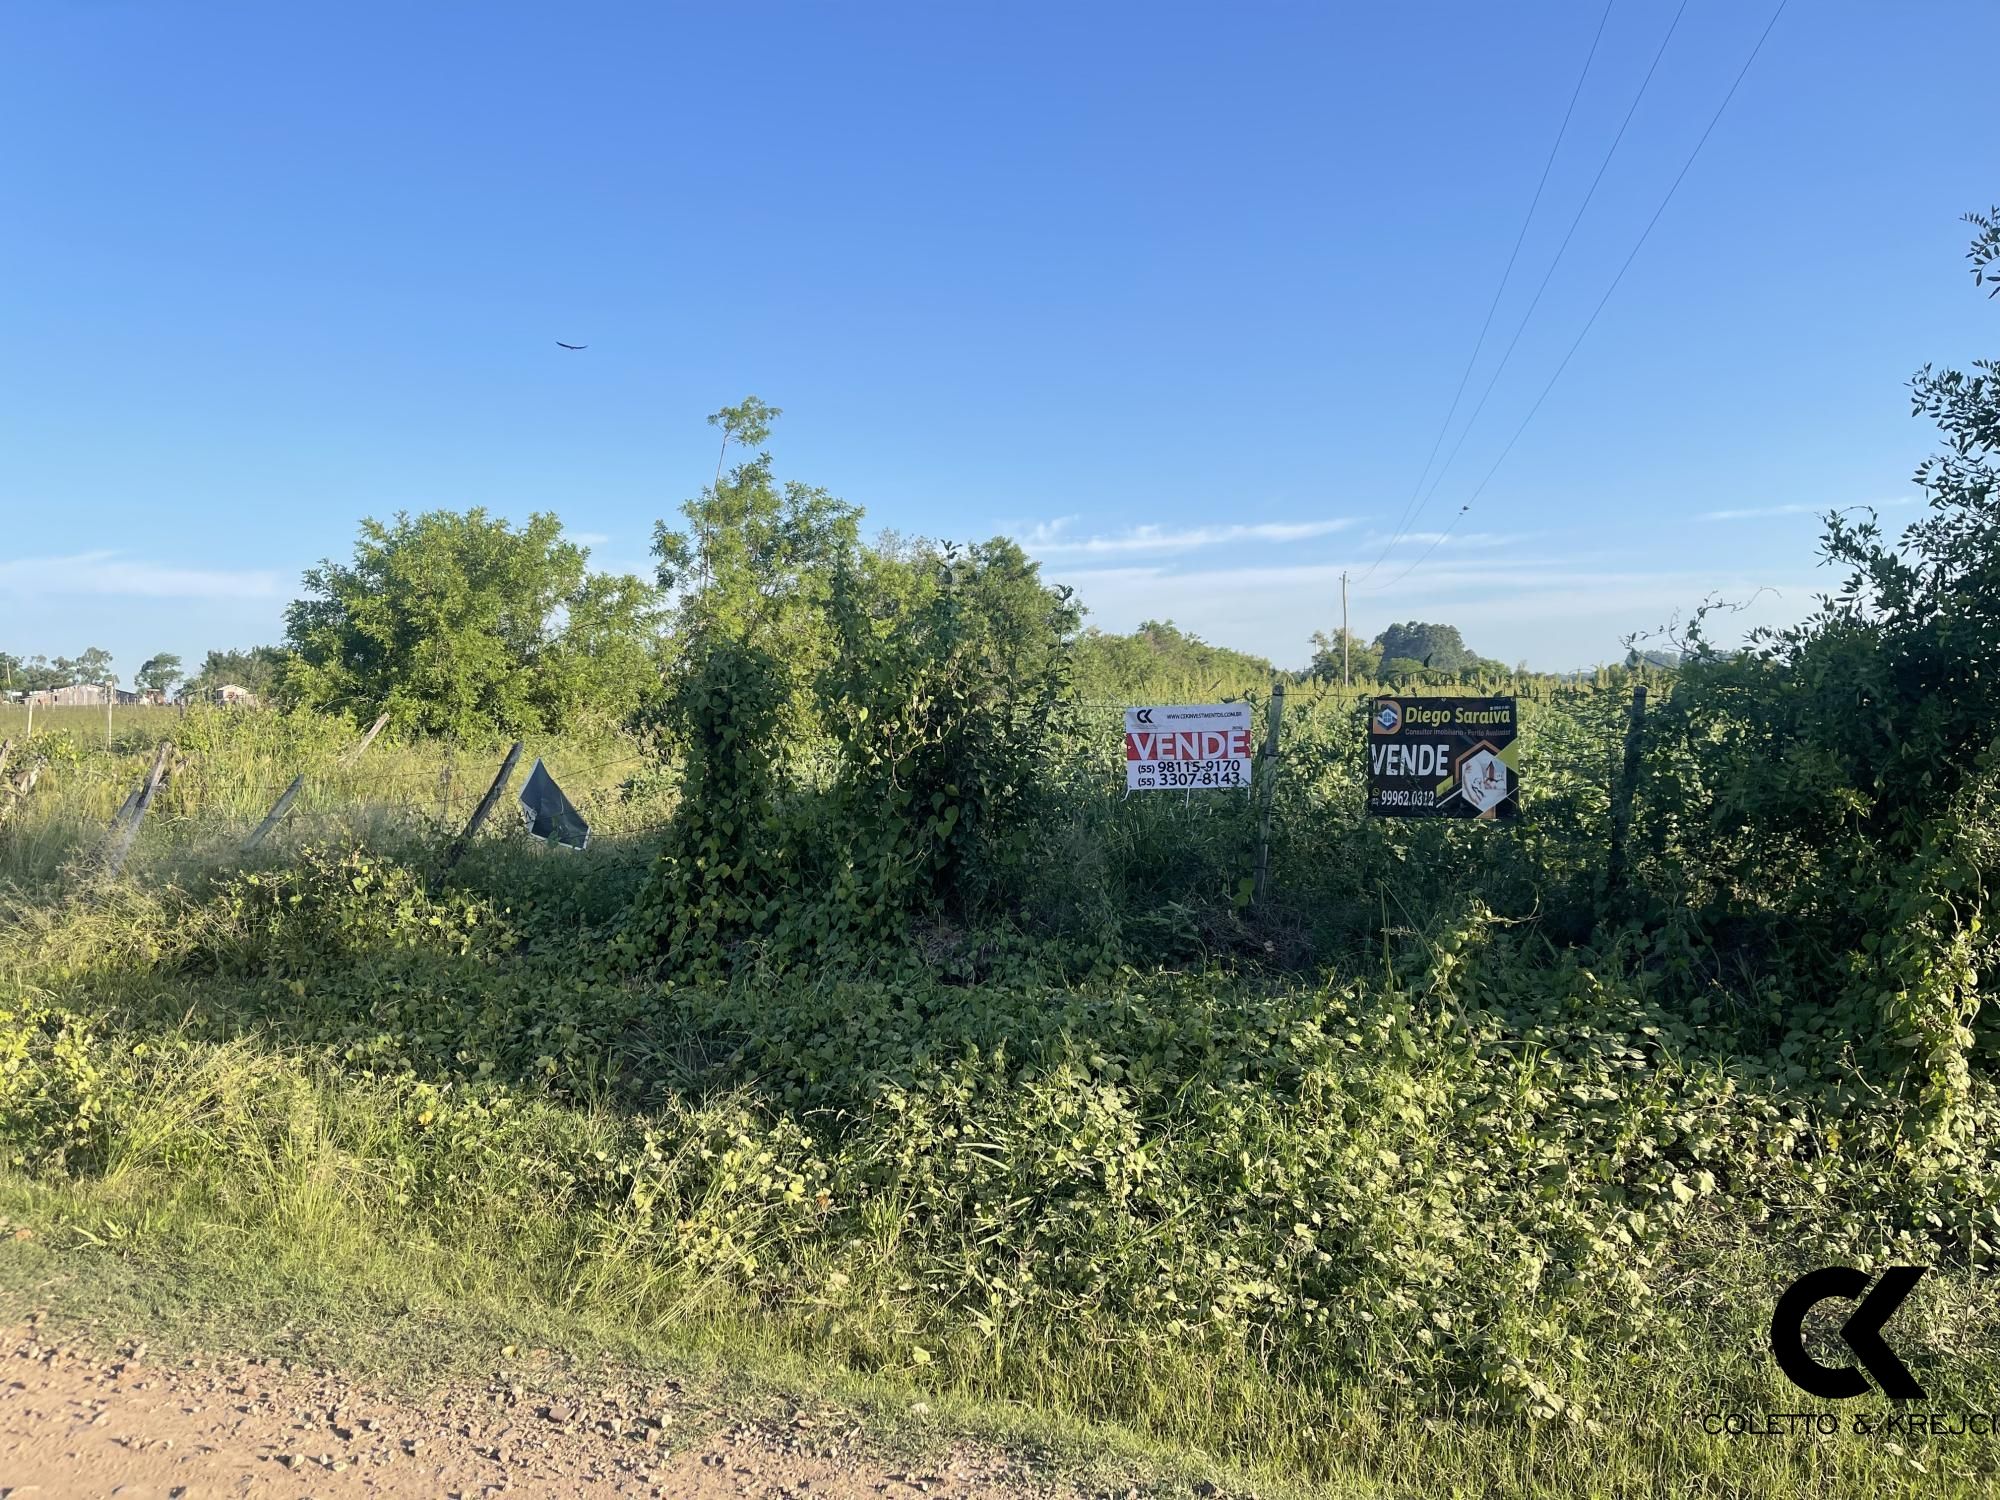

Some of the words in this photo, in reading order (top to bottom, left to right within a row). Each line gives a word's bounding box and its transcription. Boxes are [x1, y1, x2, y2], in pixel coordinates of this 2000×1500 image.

[1405, 706, 1451, 727] Diego
[1455, 707, 1511, 724] Saraiva
[1131, 730, 1246, 760] VENDE
[1138, 764, 1155, 774] (55)
[1157, 760, 1241, 773] 98115-9170
[1371, 744, 1449, 776] VENDE
[1138, 778, 1155, 787] (55)
[1159, 773, 1240, 786] 3307-8143
[1381, 790, 1434, 806] 99962.0312
